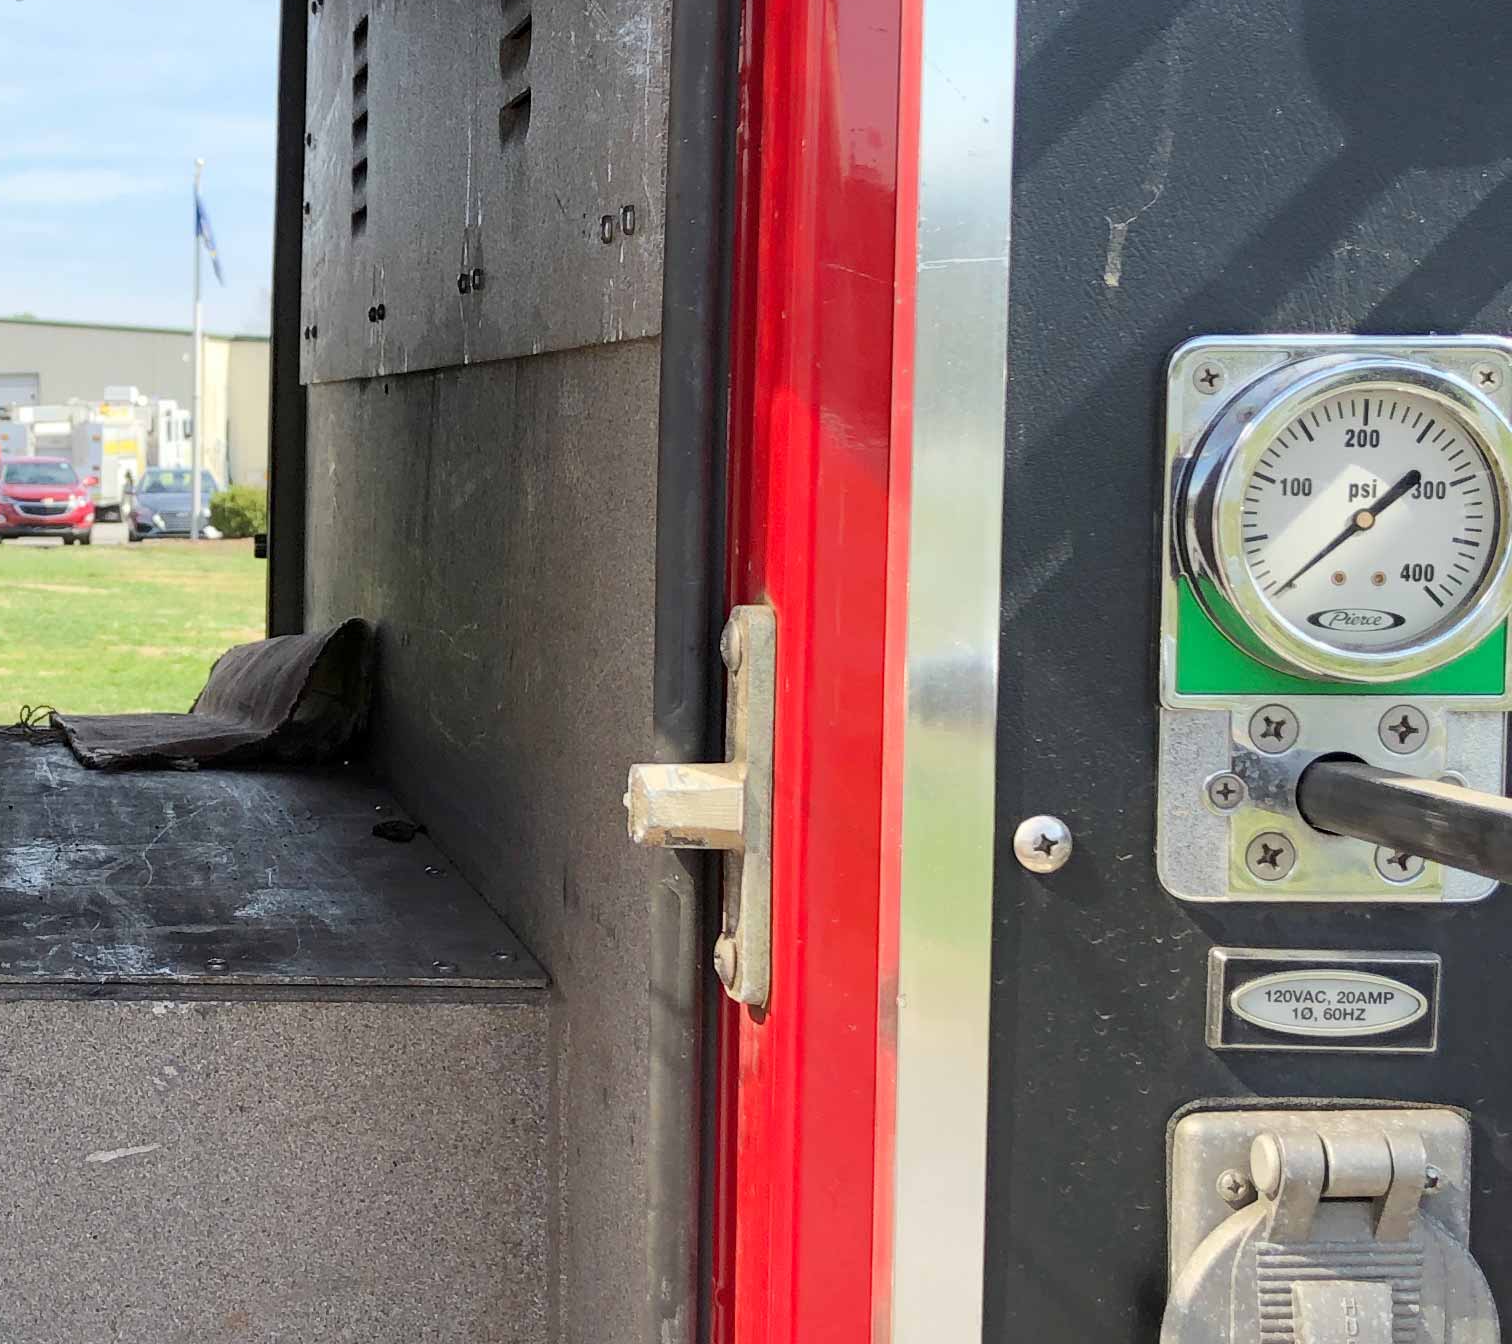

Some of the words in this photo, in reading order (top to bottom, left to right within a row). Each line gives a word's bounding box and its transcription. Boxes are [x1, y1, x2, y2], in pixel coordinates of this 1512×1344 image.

[1344, 429, 1380, 448] 200
[1280, 478, 1312, 497] 100
[1348, 478, 1378, 502] psi
[1411, 481, 1446, 500] 300
[1400, 564, 1434, 583] 400
[1327, 611, 1382, 628] Pierce
[1265, 990, 1331, 1005] 120VAC,
[1336, 991, 1394, 1004] 20AMP
[1323, 1008, 1366, 1021] 60HZ
